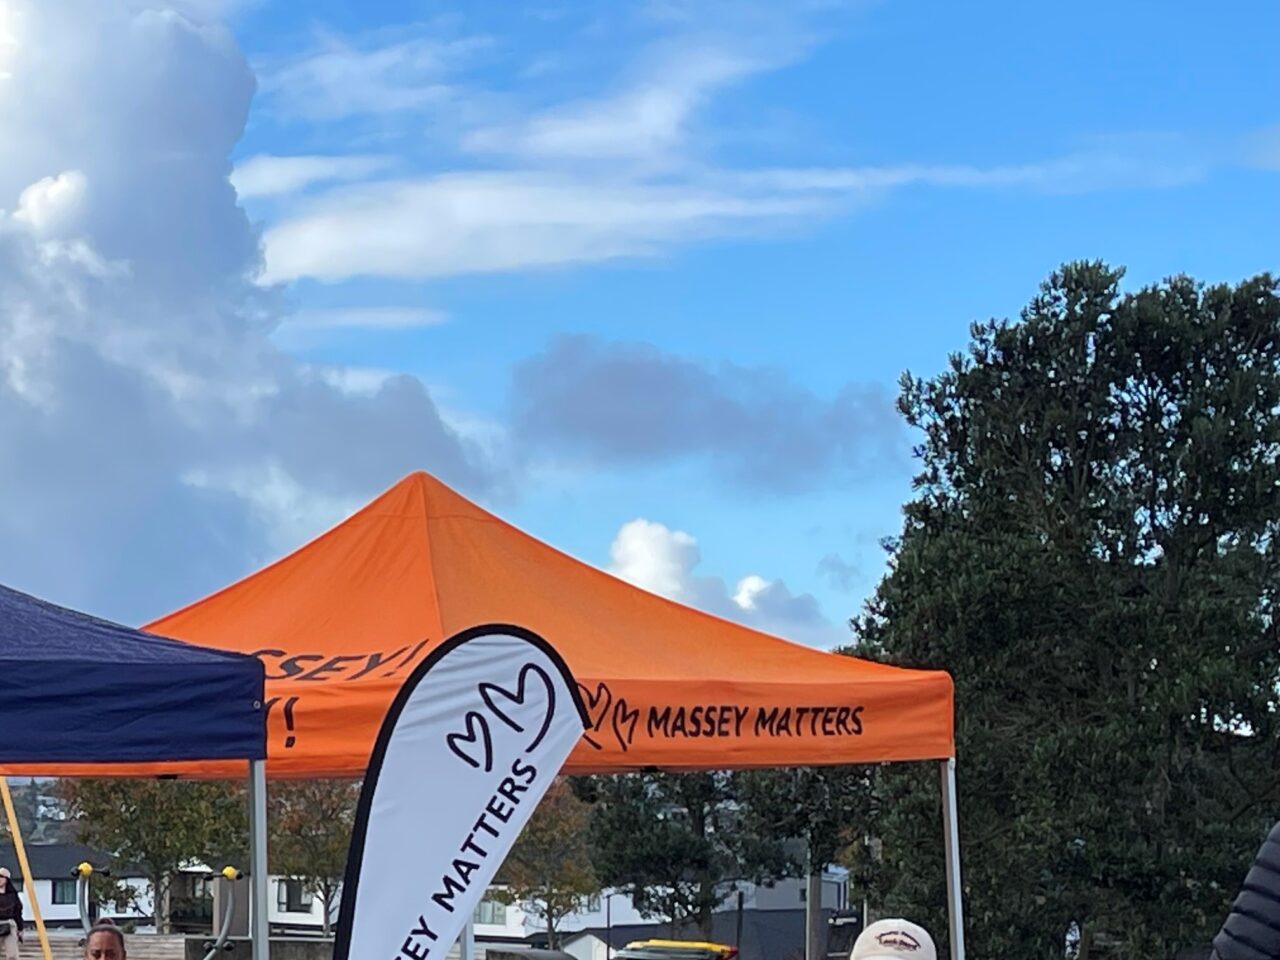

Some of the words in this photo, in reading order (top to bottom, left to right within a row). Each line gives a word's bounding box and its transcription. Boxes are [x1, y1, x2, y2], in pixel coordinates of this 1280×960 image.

[647, 705, 749, 738] MASSEY
[754, 706, 864, 737] MATTERS
[431, 758, 537, 913] MATTERS
